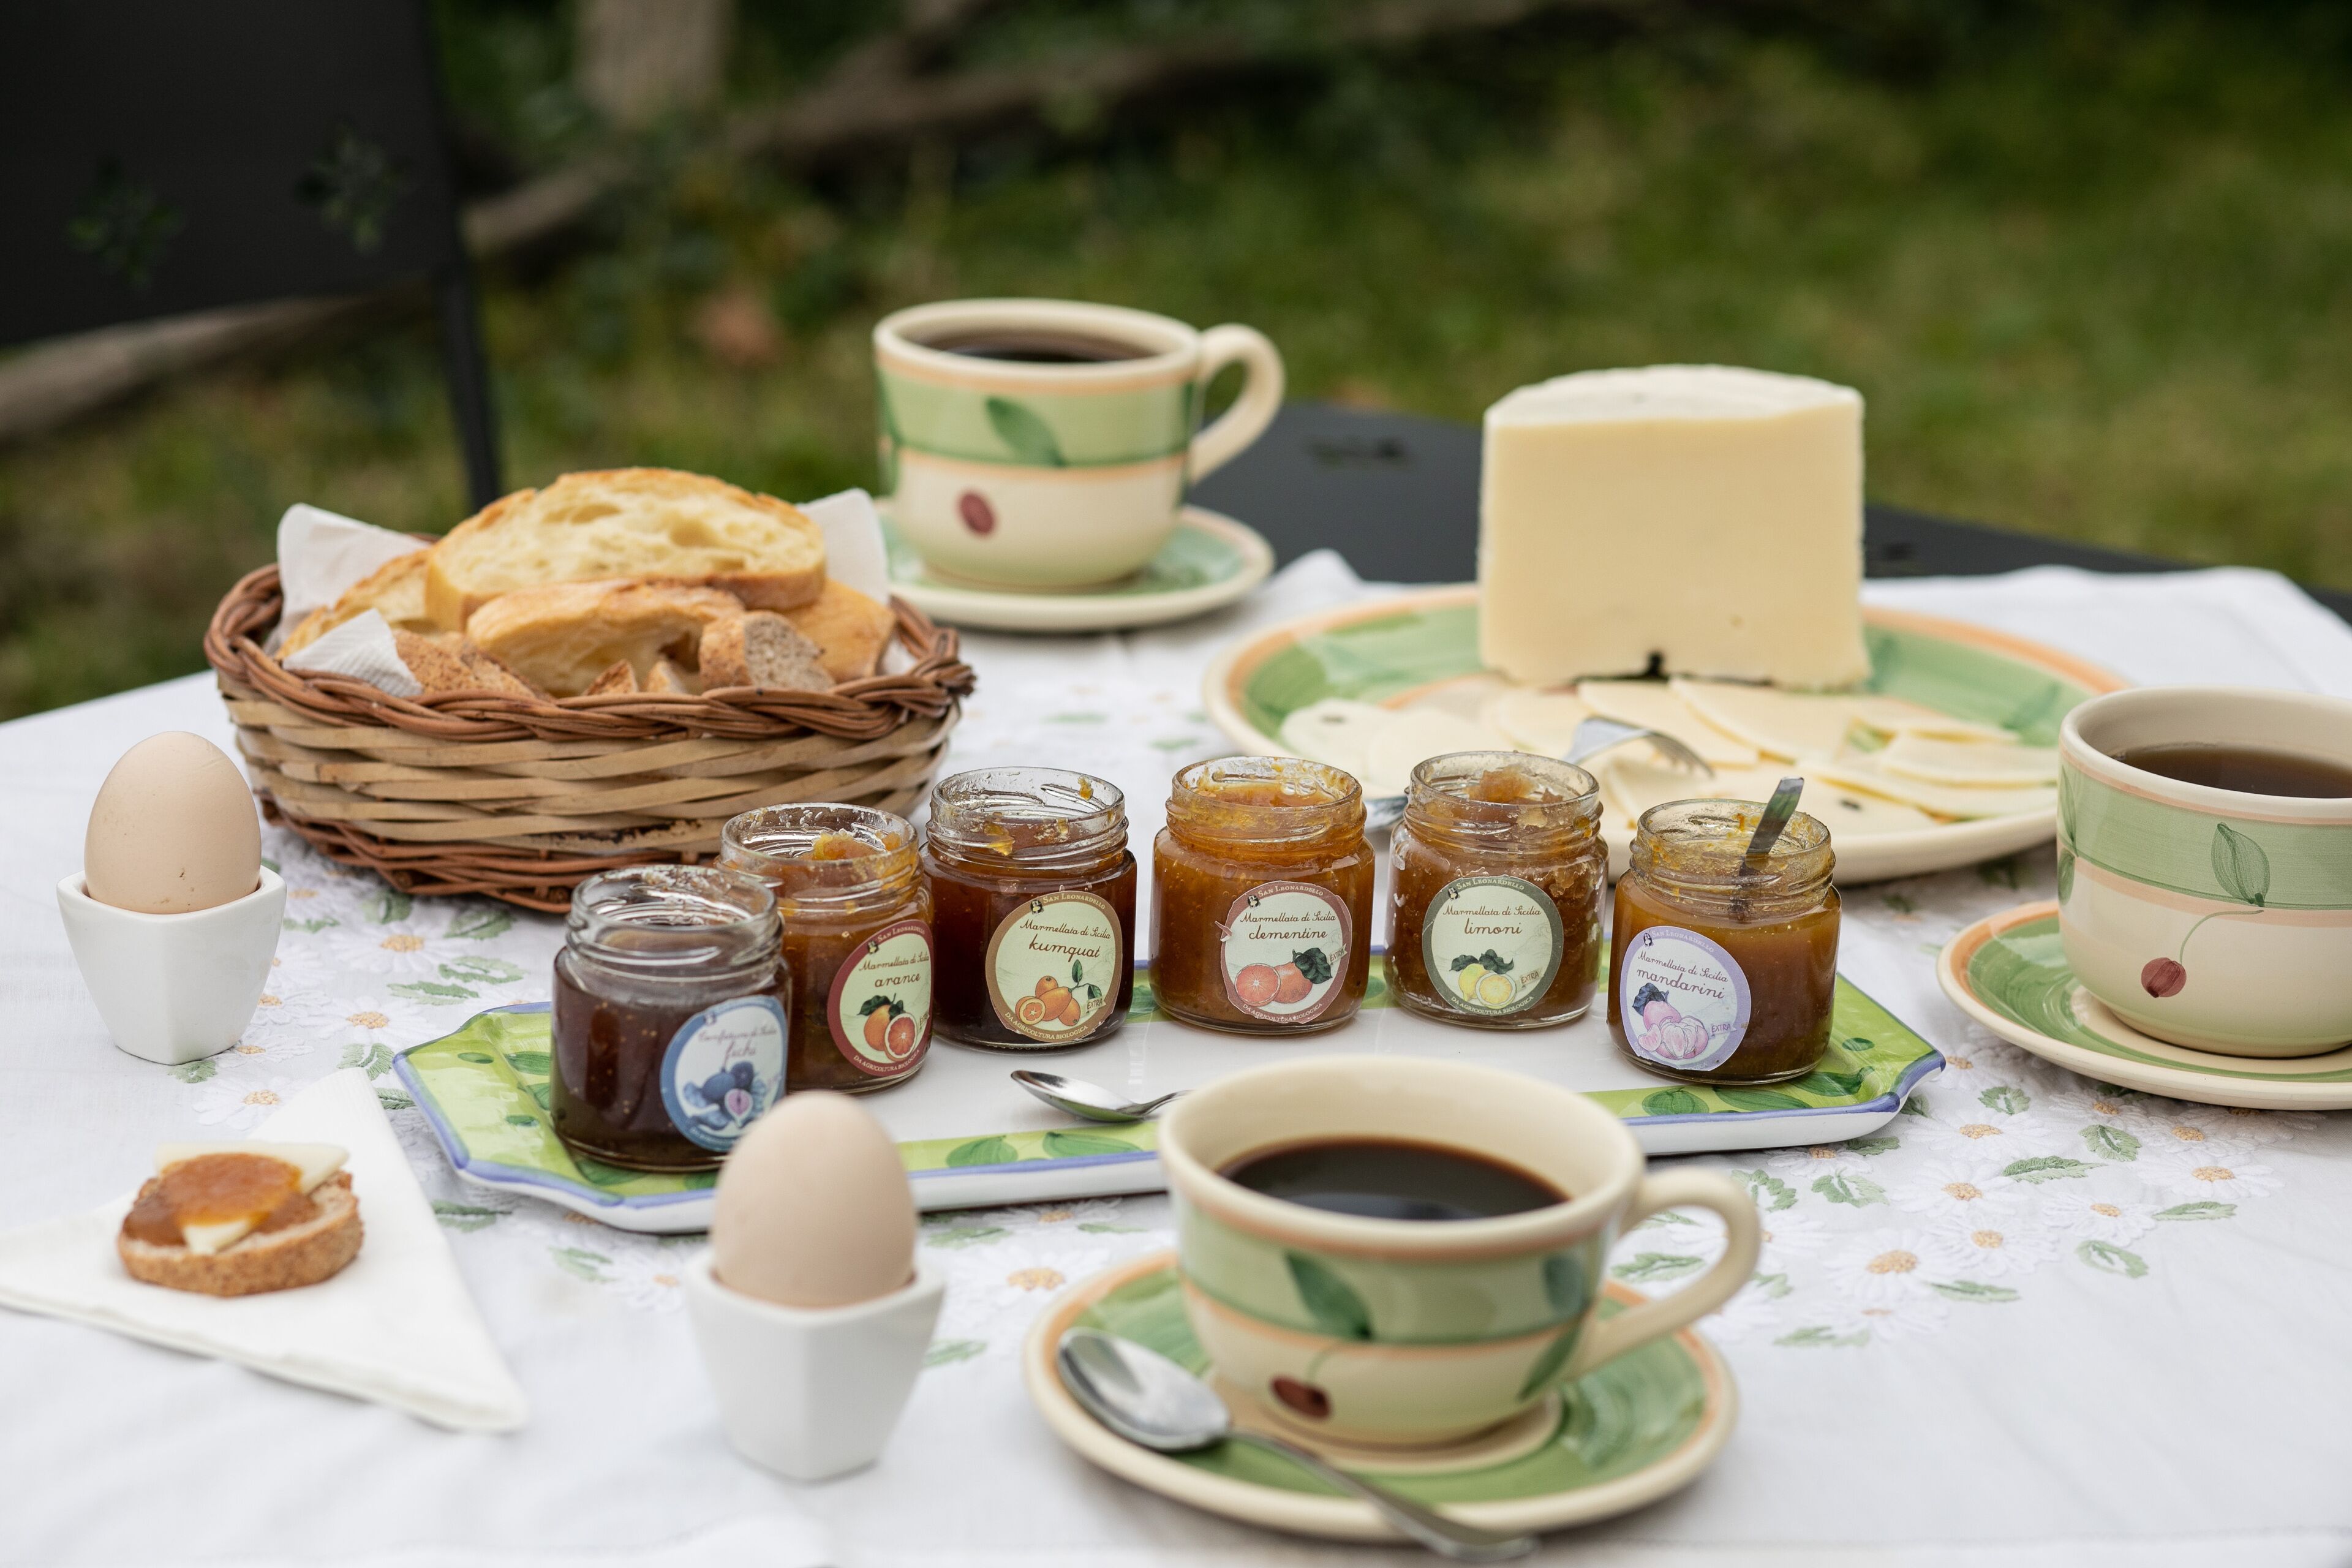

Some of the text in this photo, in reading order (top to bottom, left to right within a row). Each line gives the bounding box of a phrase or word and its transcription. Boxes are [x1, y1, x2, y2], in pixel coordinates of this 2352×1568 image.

[1258, 886, 1324, 897] SAN LEONARDELLO
[1456, 878, 1524, 891] SAN LEONARDELLO
[1042, 893, 1106, 910] SAN LEONARDELLO
[1240, 911, 1336, 922] Marmellata di Sicilia
[1443, 905, 1542, 916] Marmellata di Sicilia
[1020, 919, 1111, 939] Marmellata di Sicilia
[1249, 924, 1328, 940] clementine
[1464, 918, 1523, 934] limoni
[877, 931, 892, 942] SAN
[1652, 929, 1714, 952] SAN LEONARDELLO
[1029, 933, 1101, 962] kumquat
[1330, 949, 1345, 961] EXTRA
[859, 956, 909, 971] Marmellata
[910, 953, 917, 963] di
[1638, 951, 1728, 982] Marmellata di Sicilia
[875, 973, 921, 987] arance
[1521, 971, 1539, 984] EXTRA
[1637, 968, 1725, 999] mandarini
[1087, 998, 1103, 1009] EXTRA
[1451, 996, 1534, 1015] DA AGRICOLTURA BIOLOGICA
[1005, 1012, 1088, 1039] DA AGRICOLTURA BIOLOGICA
[1711, 1023, 1731, 1033] EXTRA
[853, 1049, 919, 1072] DA AGRICOLTURA BIOLOGICA
